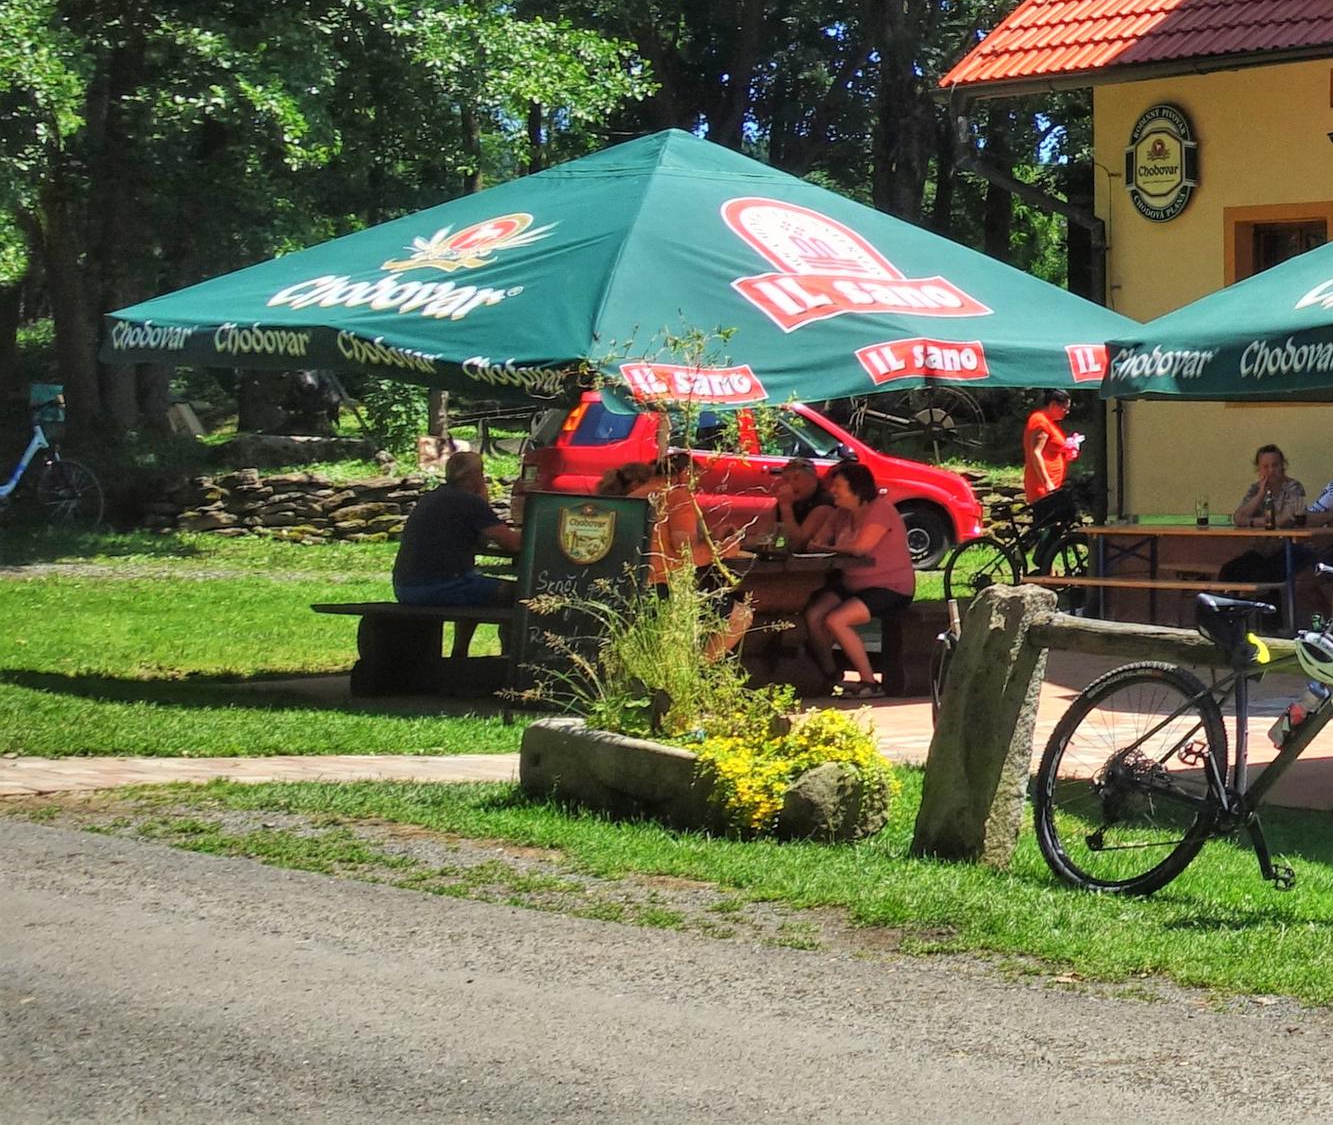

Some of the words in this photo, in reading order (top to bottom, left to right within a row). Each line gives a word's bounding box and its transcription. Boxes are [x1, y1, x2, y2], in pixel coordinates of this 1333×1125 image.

[1138, 164, 1179, 178] Chodovar
[267, 273, 505, 322] Chodovar
[753, 277, 834, 317] IL
[832, 280, 964, 310] sano
[112, 320, 194, 351] Chodovar
[214, 322, 311, 357] Chodovar
[866, 345, 906, 376] IL
[912, 344, 979, 372] sano
[1073, 347, 1102, 374] IL
[1111, 344, 1214, 381] Chodovar
